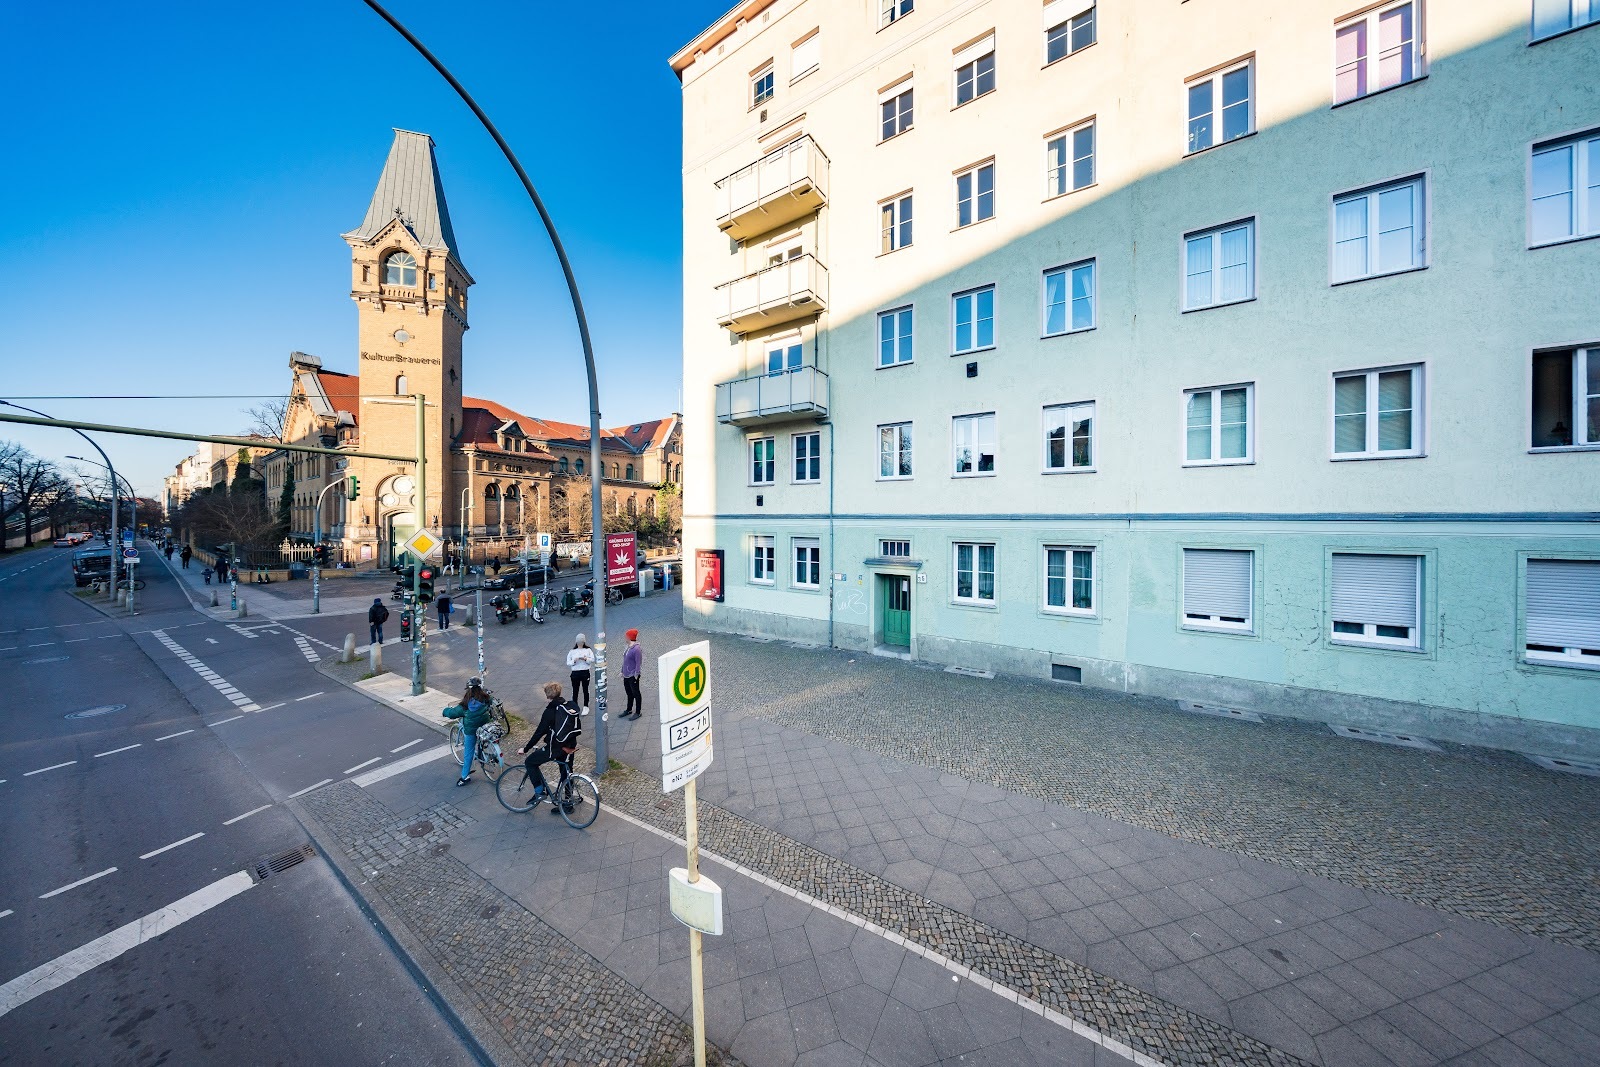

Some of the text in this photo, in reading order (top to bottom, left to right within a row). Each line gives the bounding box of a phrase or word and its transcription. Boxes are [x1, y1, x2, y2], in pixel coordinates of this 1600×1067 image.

[360, 351, 441, 366] KulturBrauerei
[684, 666, 700, 696] H
[676, 726, 689, 741] 23
[696, 719, 702, 730] 7
[702, 715, 707, 726] h
